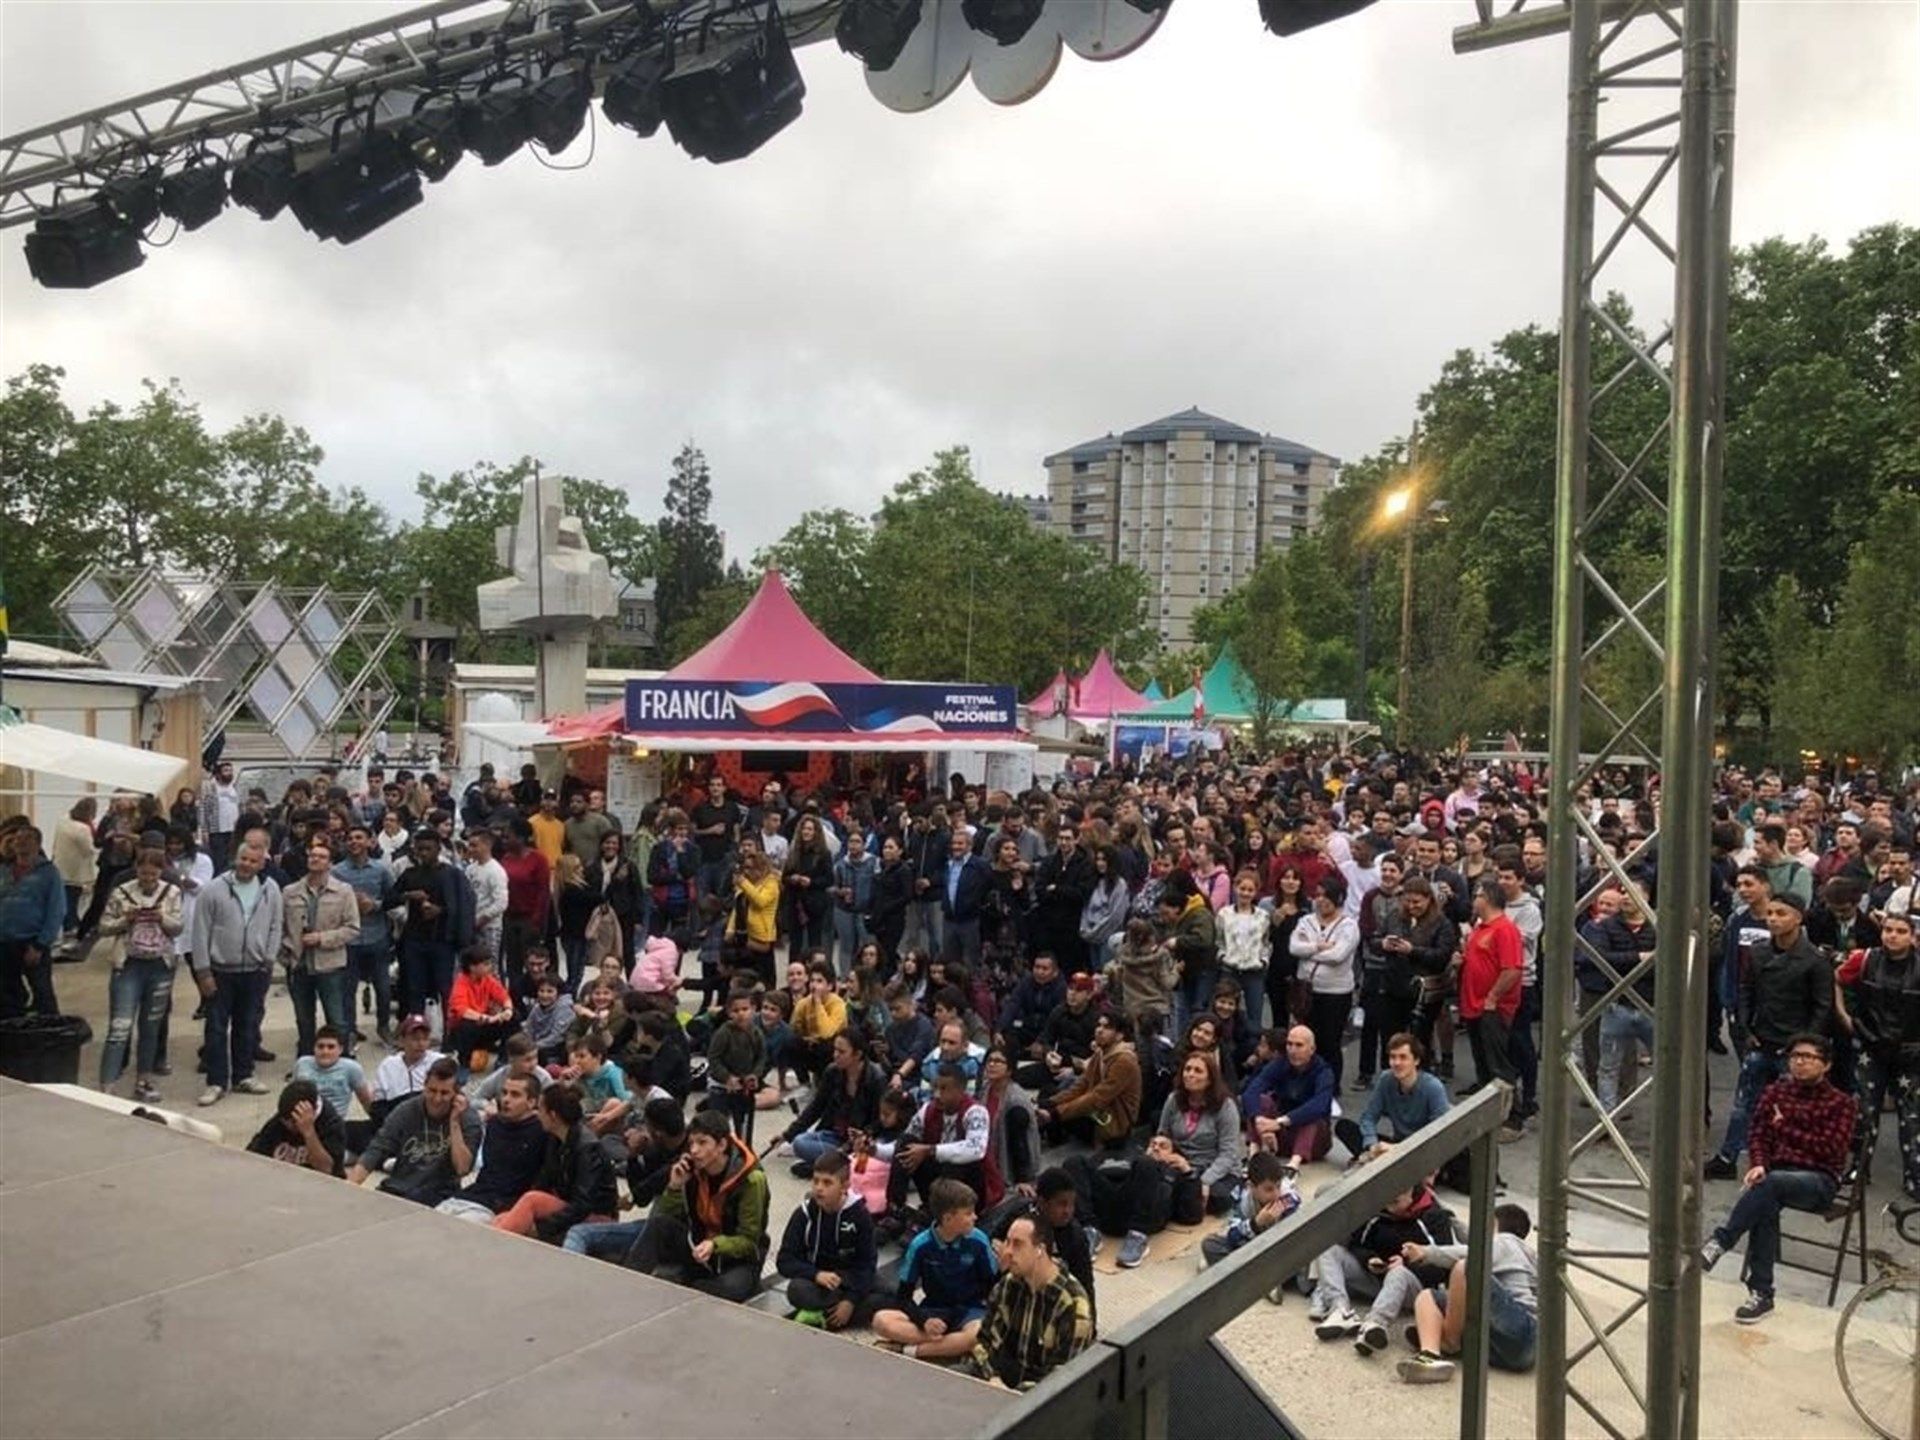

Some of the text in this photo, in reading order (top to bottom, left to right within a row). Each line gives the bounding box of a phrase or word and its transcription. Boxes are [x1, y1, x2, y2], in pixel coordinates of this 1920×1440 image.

[640, 689, 736, 719] FRANCIA
[945, 694, 996, 704] FESTIVAL
[933, 710, 1008, 723] NACIONES
